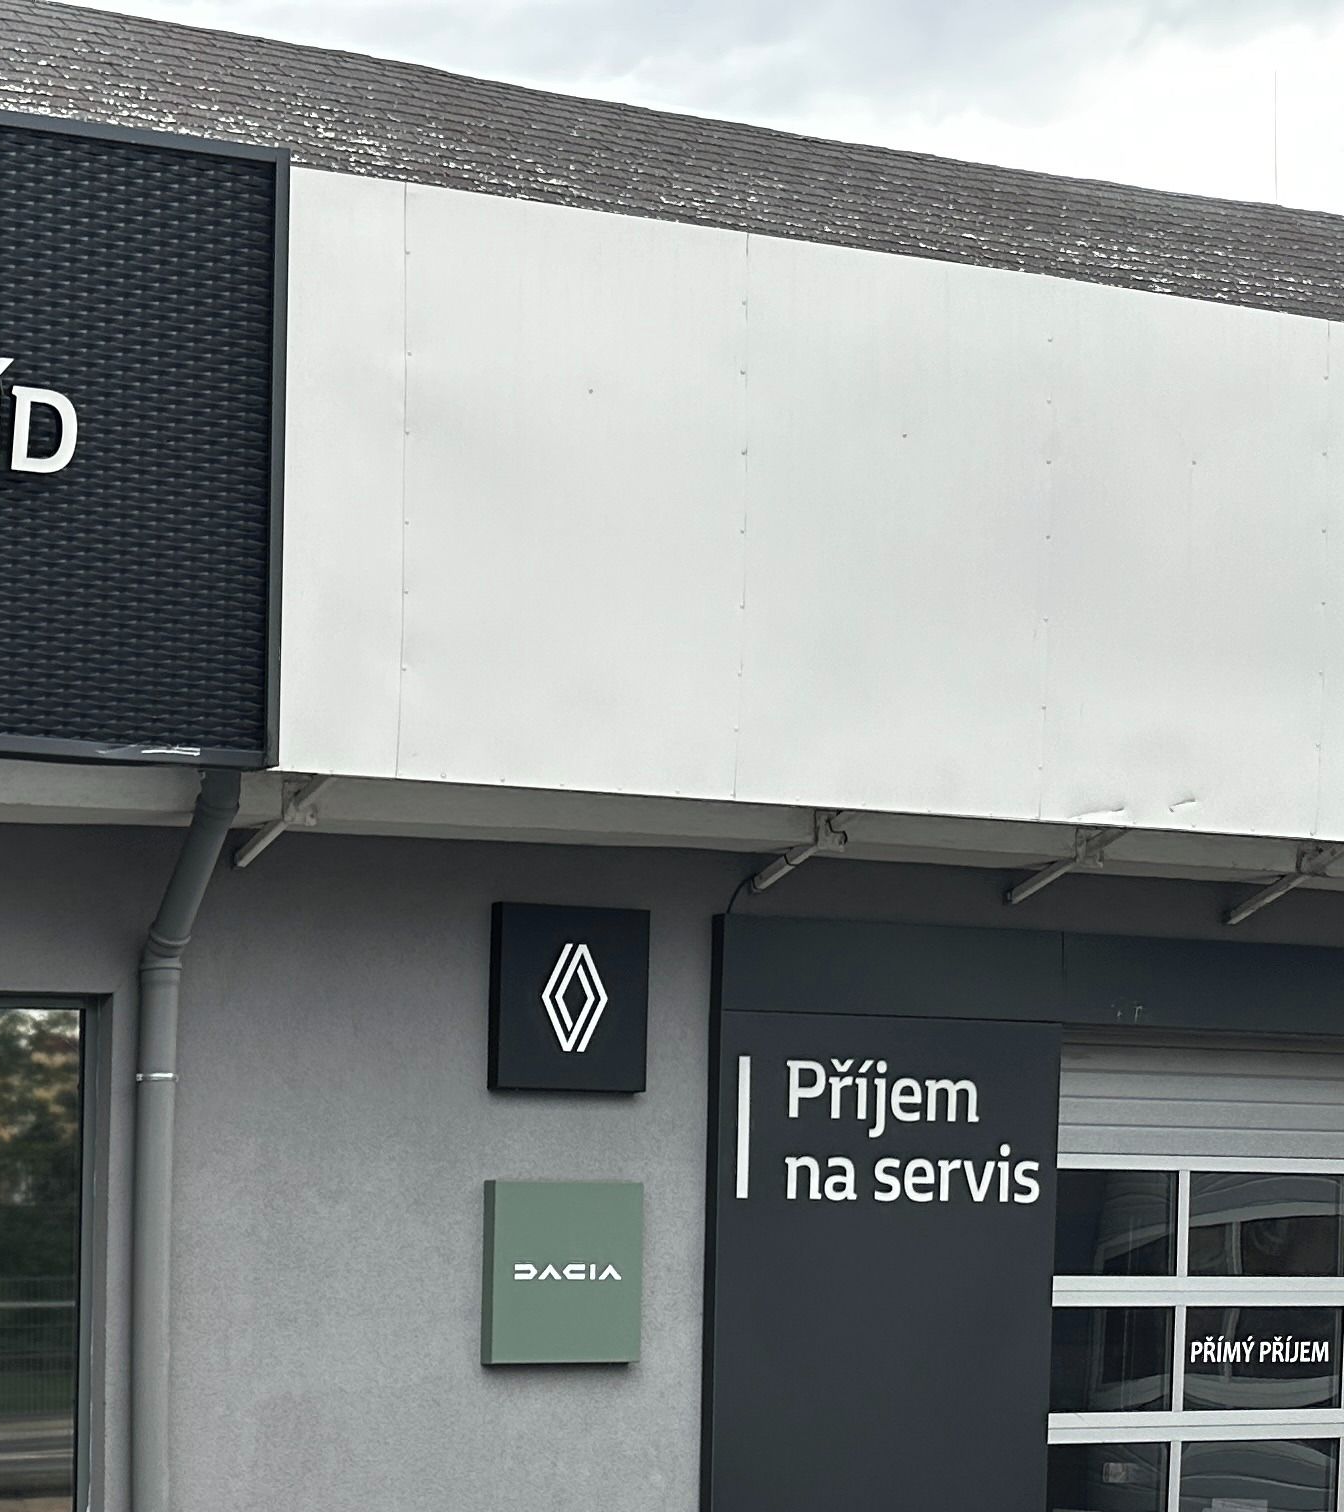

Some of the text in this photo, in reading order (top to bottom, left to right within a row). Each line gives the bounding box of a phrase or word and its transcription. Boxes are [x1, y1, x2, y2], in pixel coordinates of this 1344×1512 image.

[786, 1058, 979, 1138] Příjem
[785, 1143, 1040, 1203] na servis
[514, 1263, 622, 1281] DACIA
[1190, 1335, 1330, 1364] PŘÍMÝ PŘÍJEM
